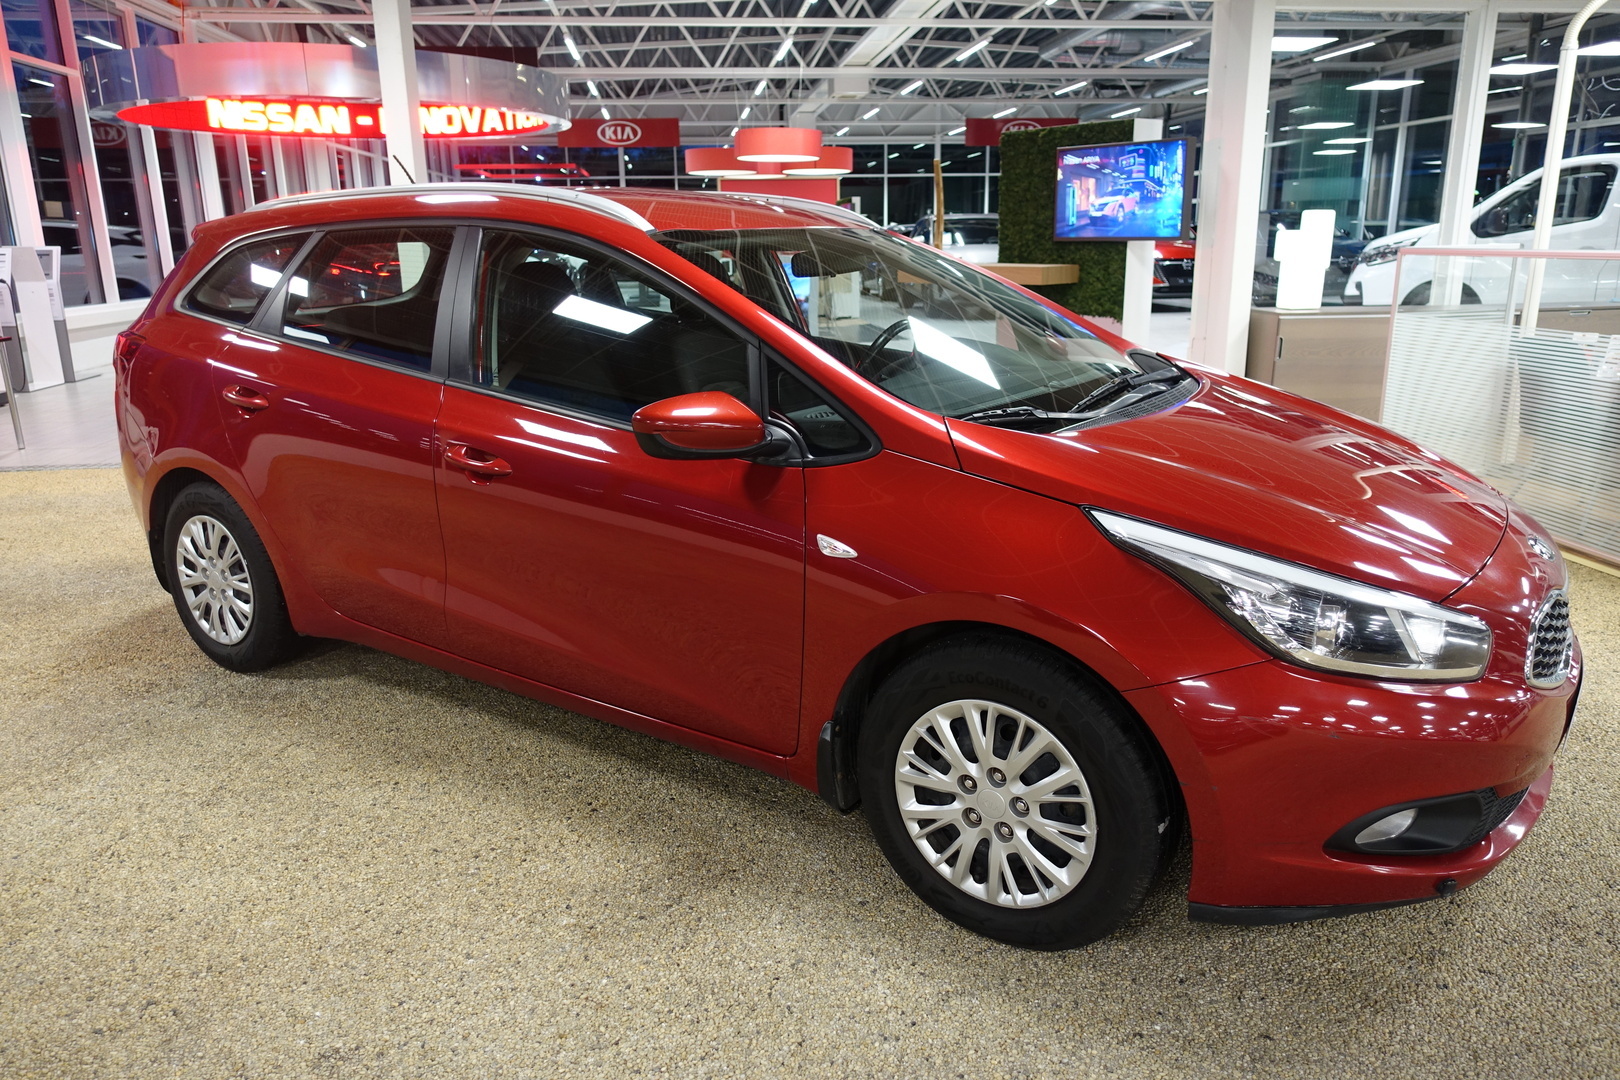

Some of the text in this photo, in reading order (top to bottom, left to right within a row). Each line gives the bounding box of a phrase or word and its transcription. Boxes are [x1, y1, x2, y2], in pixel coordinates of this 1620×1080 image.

[206, 98, 351, 134] NISSAN
[604, 126, 634, 140] KIA
[947, 671, 1050, 709] EcoContact 6
